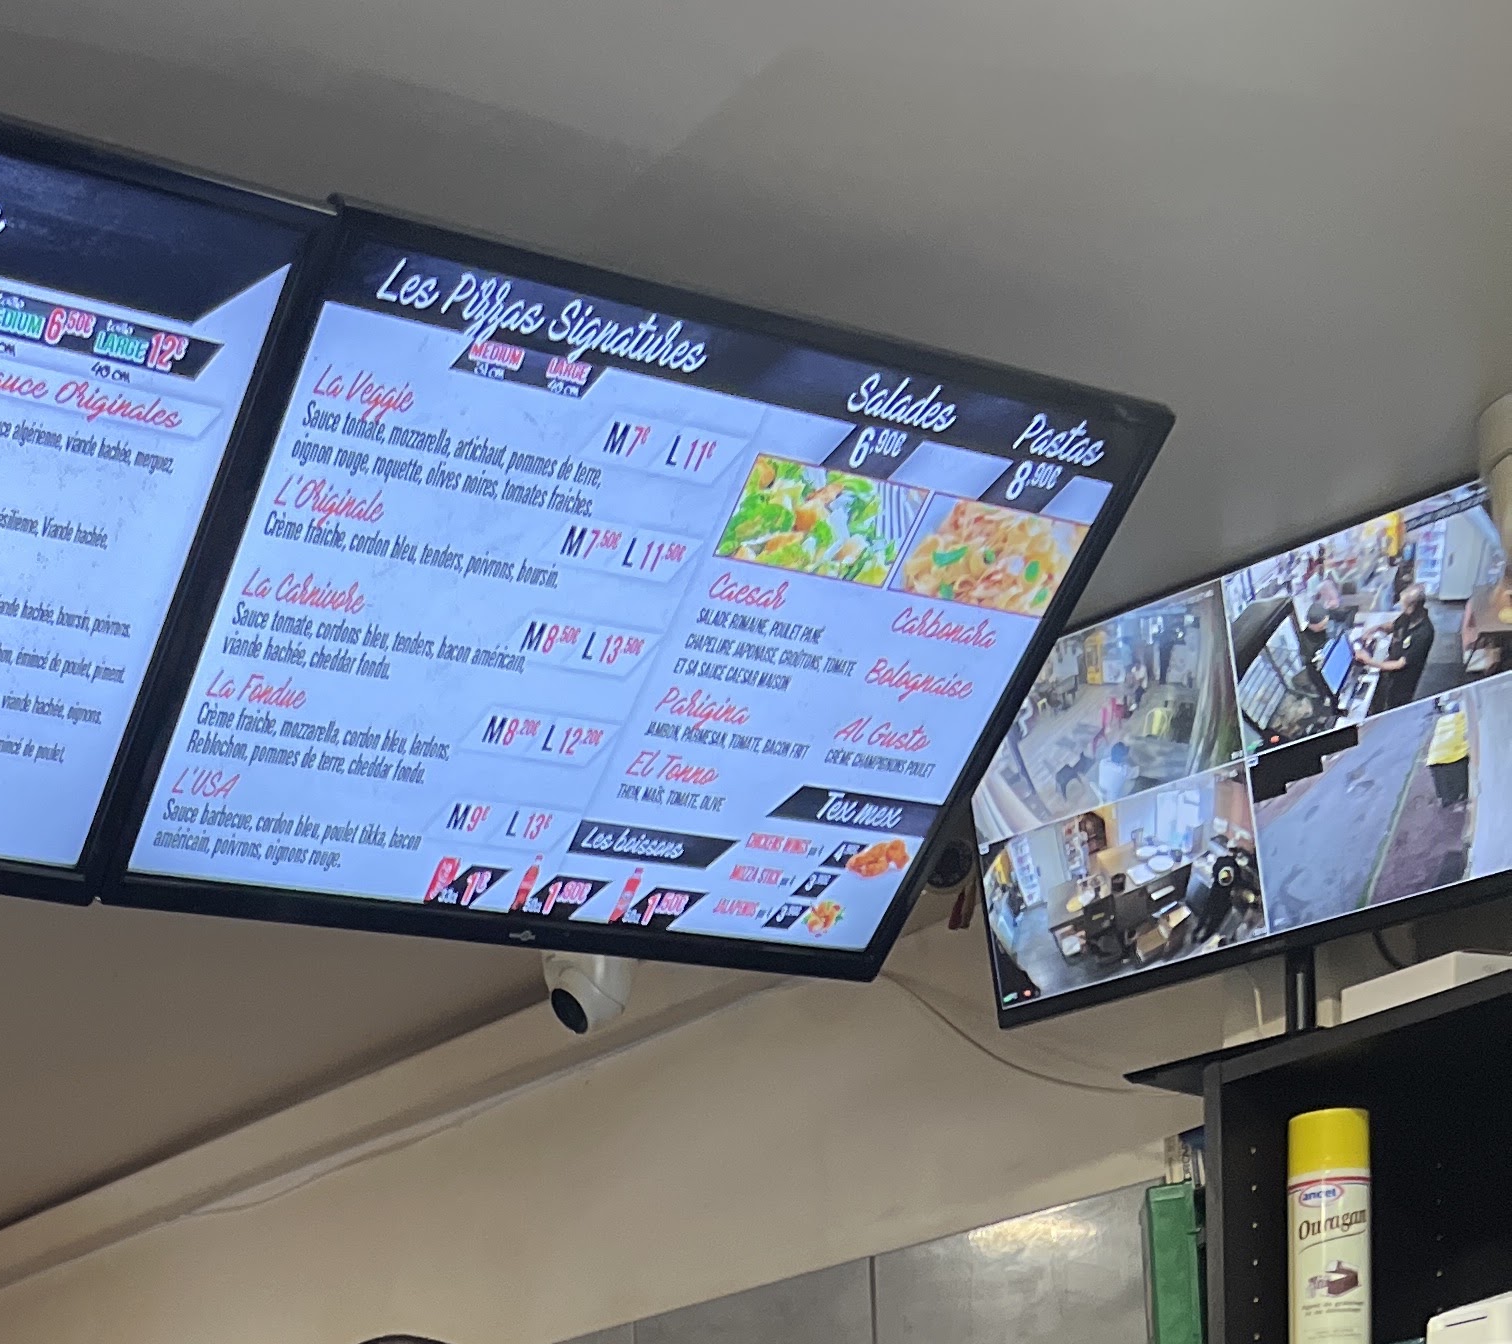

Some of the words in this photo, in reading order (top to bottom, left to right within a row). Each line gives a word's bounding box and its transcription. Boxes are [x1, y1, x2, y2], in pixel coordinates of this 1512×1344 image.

[376, 257, 440, 308] Les
[441, 271, 544, 342] Pizzas
[548, 299, 706, 372] Signatures
[94, 331, 148, 367] LARGE
[54, 380, 183, 431] Originales
[314, 364, 343, 397] La
[345, 370, 414, 424] Veggie
[847, 372, 957, 434] Salades
[302, 400, 340, 430] Sauce
[343, 415, 386, 443] tomate,
[389, 420, 451, 459] mozzarella,
[603, 421, 629, 456] M
[665, 435, 683, 467] L
[1012, 412, 1105, 468] Pastas
[560, 526, 587, 557] M
[621, 538, 638, 567] L
[241, 566, 275, 598] La
[276, 569, 366, 615] Carnivore
[708, 572, 786, 612] Caesar
[891, 606, 998, 650] Carbonara
[205, 669, 235, 699] La
[240, 673, 308, 710] Fondue
[864, 658, 974, 702] Bolognaise
[656, 686, 751, 735] Parigina
[833, 717, 862, 743] Al
[869, 726, 931, 754] Gusto
[626, 750, 654, 777] El
[655, 754, 720, 786] Tonno
[815, 791, 856, 820] Tex
[860, 805, 903, 829] mex
[580, 825, 611, 850] Les
[610, 834, 685, 859] boissons
[1302, 1189, 1336, 1201] ancel
[1299, 1209, 1367, 1240] Ouragan
